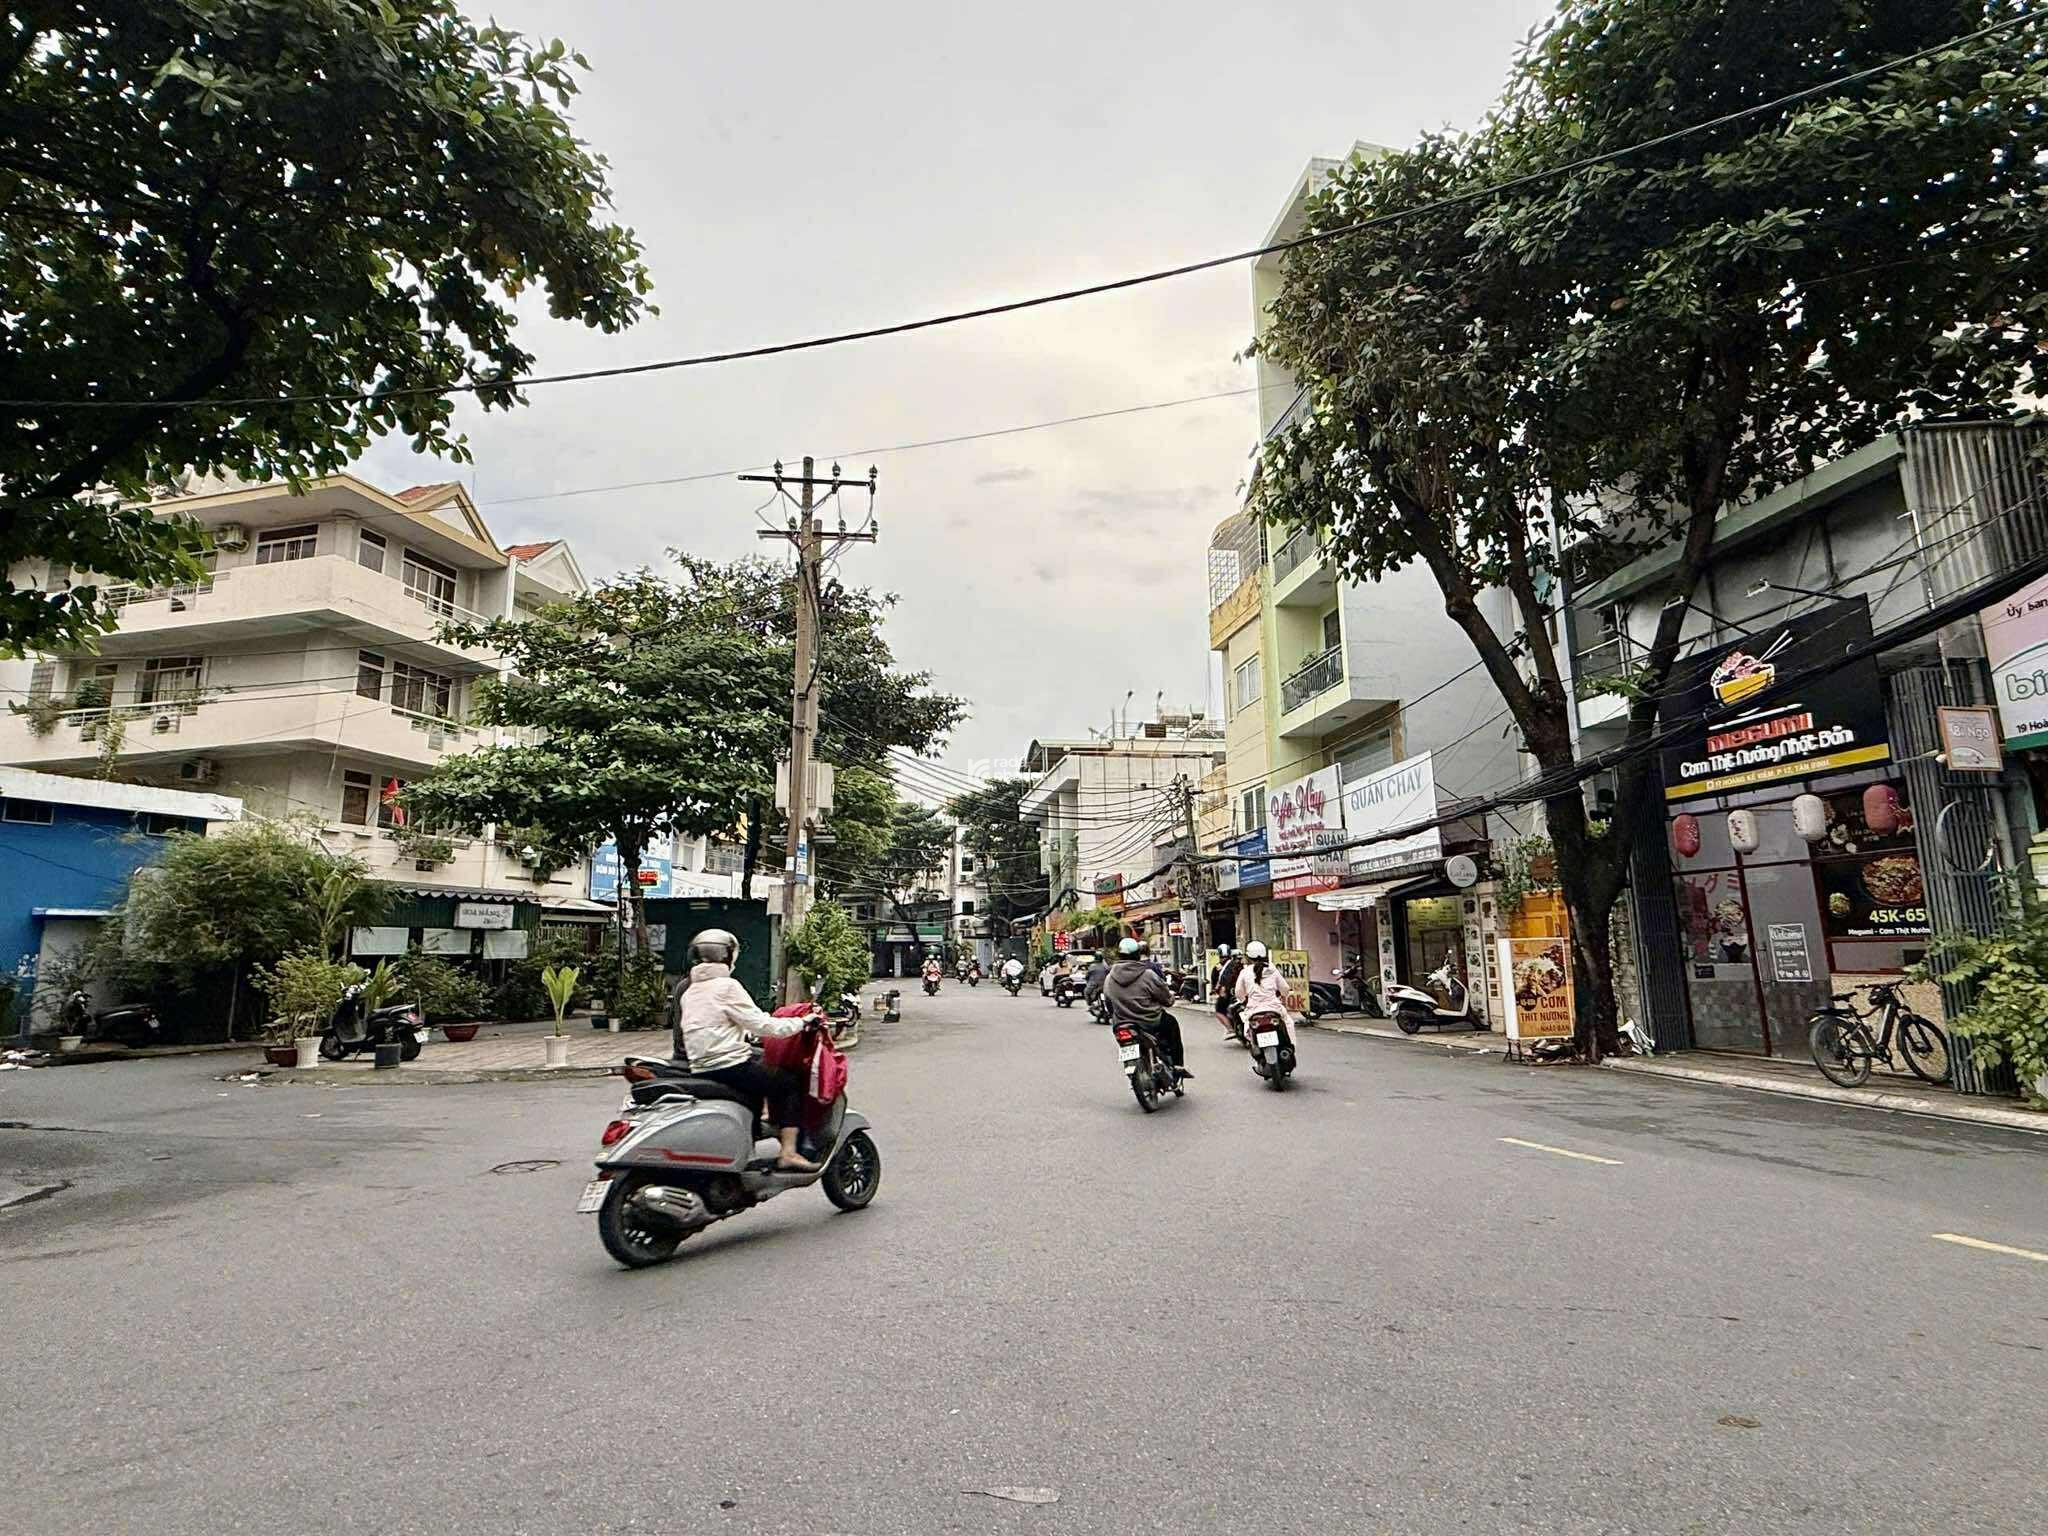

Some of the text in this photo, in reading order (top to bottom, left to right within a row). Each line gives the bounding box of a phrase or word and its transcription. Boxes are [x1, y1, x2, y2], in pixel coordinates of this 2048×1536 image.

[2016, 724, 2027, 733] 19
[1819, 725, 1855, 748] Bản
[1351, 768, 1422, 811] QUÁN CHAY
[1316, 831, 1344, 846] QUÁN
[1318, 850, 1344, 863] CHAY
[1869, 908, 1928, 923] 45K-65
[1540, 995, 1567, 1008] CƠM
